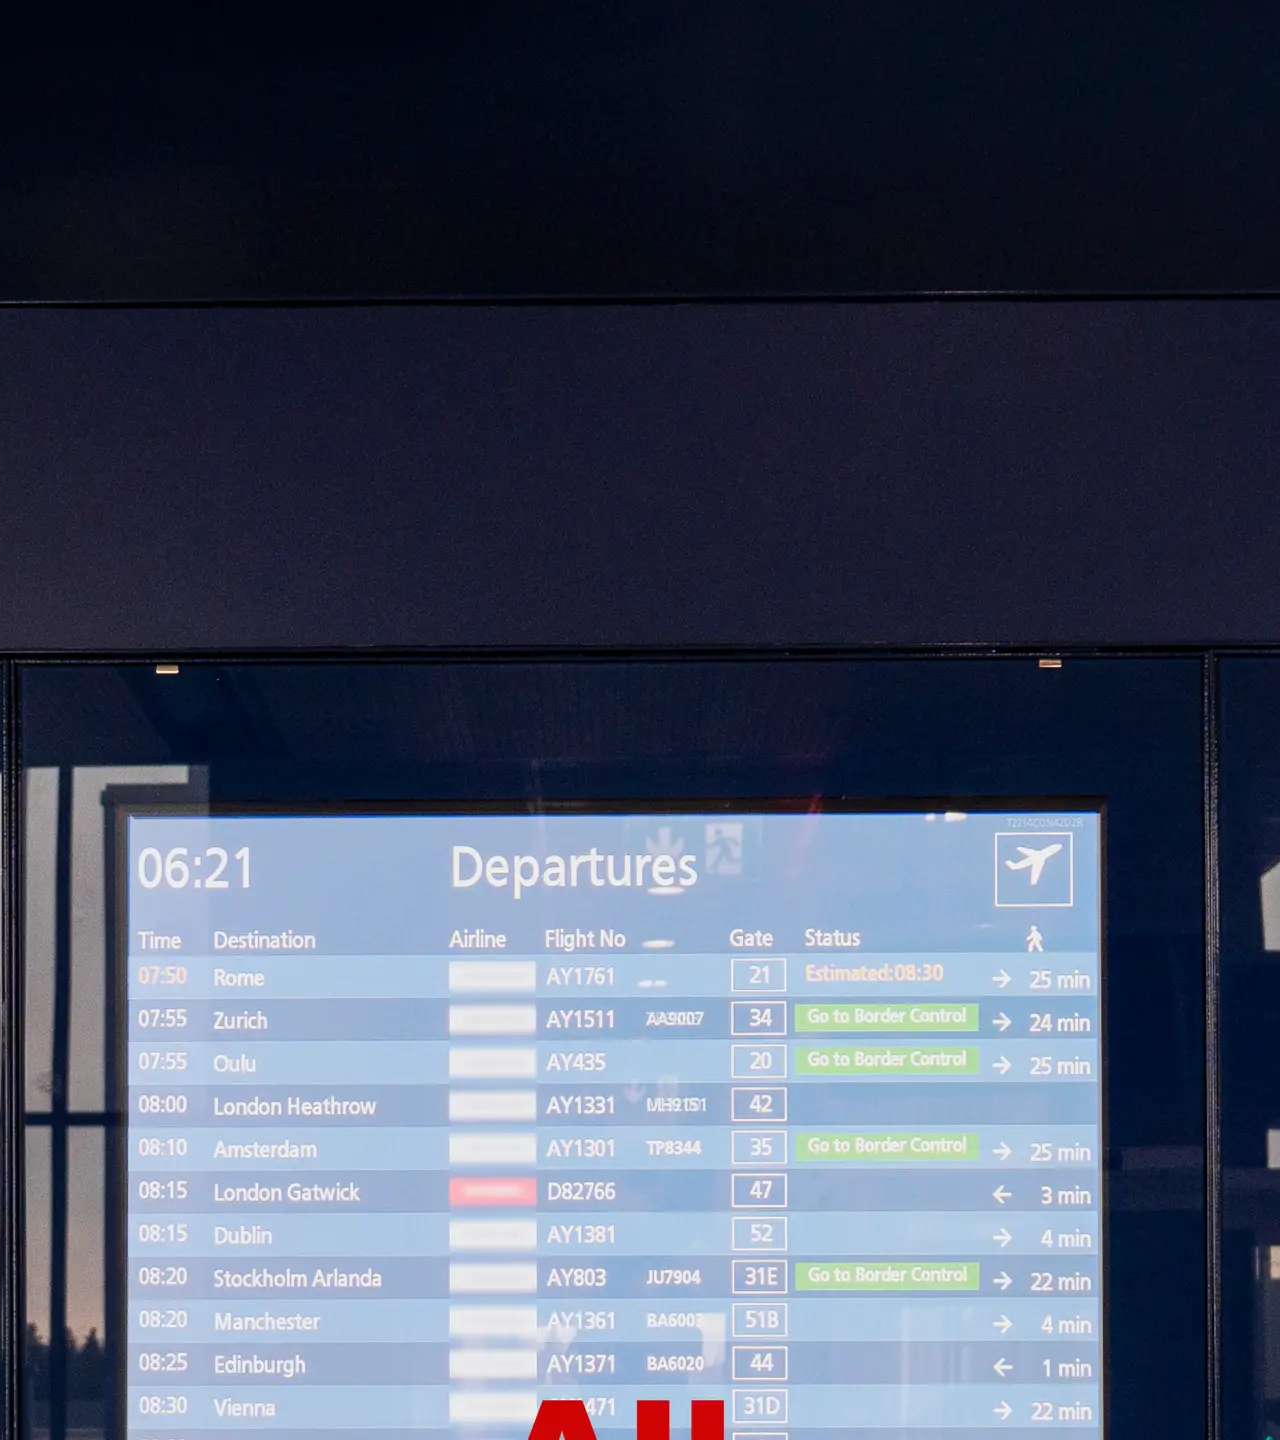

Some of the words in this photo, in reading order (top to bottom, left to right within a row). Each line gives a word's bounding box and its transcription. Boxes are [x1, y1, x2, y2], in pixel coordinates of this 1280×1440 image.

[137, 846, 250, 890] 06:21
[452, 841, 698, 900] Departures
[136, 930, 182, 950] Time
[213, 929, 316, 950] Destination
[448, 928, 507, 949] Airline
[545, 928, 595, 953] Flight
[599, 928, 627, 948] No
[729, 928, 774, 947] Gate
[804, 927, 861, 947] Status
[137, 965, 188, 985] 07:50
[213, 968, 265, 987] Rome
[546, 966, 614, 986] AY1761
[749, 965, 770, 984] 21
[1029, 970, 1052, 990] 25
[1057, 969, 1091, 990] min
[138, 1008, 188, 1028] 07:55
[213, 1010, 268, 1030] Zurich
[545, 1009, 614, 1029] AY1511
[749, 1008, 773, 1027] 34
[806, 1007, 830, 1024] Go
[831, 1008, 851, 1024] to
[855, 1006, 906, 1023] Border
[911, 1005, 967, 1023] Control
[1029, 1013, 1054, 1033] 24
[1057, 1011, 1091, 1032] min
[138, 1094, 188, 1114] 08:00
[213, 1095, 282, 1116] London
[287, 1095, 377, 1116] Heathrow
[546, 1095, 614, 1115] AY1331
[749, 1094, 773, 1114] 42
[138, 1180, 188, 1199] 08:15
[214, 1182, 283, 1202] London
[287, 1181, 361, 1202] Gatwick
[547, 1181, 616, 1201] D82766
[749, 1180, 773, 1199] 47
[1057, 1184, 1092, 1205] min
[138, 1266, 188, 1286] 08:20
[213, 1268, 308, 1288] Stockholm
[311, 1267, 382, 1288] Arlanda
[546, 1267, 607, 1287] AY803
[646, 1268, 702, 1285] JU7904
[745, 1266, 778, 1286] 31E
[807, 1266, 831, 1283] Go
[832, 1267, 851, 1283] to
[855, 1265, 906, 1282] Border
[911, 1265, 968, 1282] Control
[1030, 1272, 1054, 1292] 22
[1058, 1271, 1092, 1291] min
